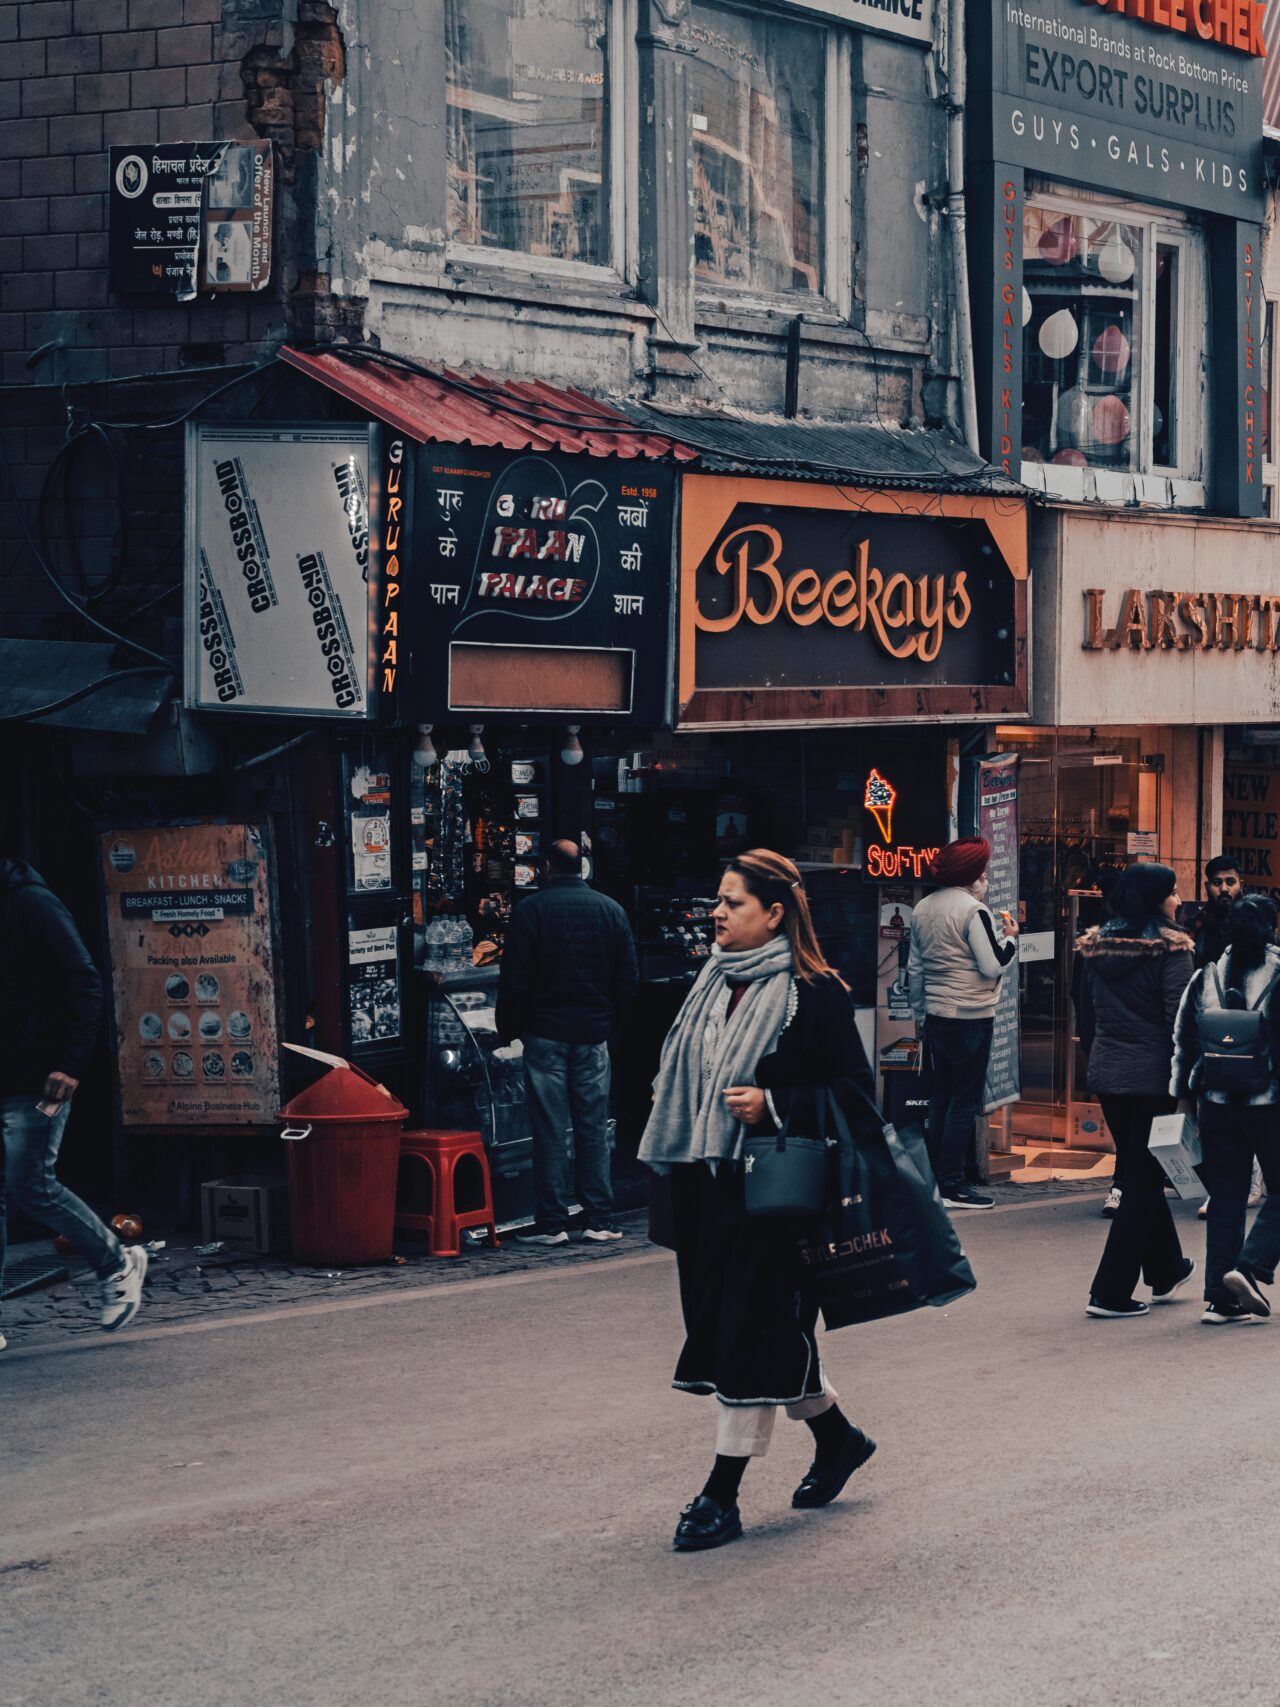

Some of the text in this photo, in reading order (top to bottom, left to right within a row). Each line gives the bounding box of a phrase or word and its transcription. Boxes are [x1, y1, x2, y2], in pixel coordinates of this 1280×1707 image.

[1192, 0, 1267, 57] CHEK
[1007, 3, 1087, 45] International
[1090, 28, 1131, 59] Brands
[1134, 47, 1146, 64] at
[1149, 47, 1176, 73] Rock
[1178, 56, 1218, 84] Bottom
[1221, 68, 1249, 94] Price
[1025, 43, 1236, 138] EXPORT SURPLUS
[152, 155, 210, 174] हिमाचल प्रदेश
[1012, 110, 1247, 192] GUYS GALS KIDS
[252, 154, 263, 279] Offer of the Month
[261, 170, 271, 263] New Launch and
[1003, 181, 1016, 270] GUYS
[1244, 243, 1254, 369] STYLE
[1001, 284, 1015, 373] GALS
[1001, 388, 1012, 476] KIDS
[1245, 385, 1255, 484] CHEK
[386, 441, 403, 550] GURU
[436, 489, 464, 522] गुरु
[621, 486, 657, 498] Estd. 1958
[617, 499, 648, 528] लबों
[438, 527, 458, 558] के
[492, 526, 586, 563] PAAN
[620, 543, 643, 571] की
[430, 584, 460, 605] पान
[478, 572, 588, 601] PALACE
[694, 523, 972, 662] Beekays
[613, 594, 644, 615] शान
[382, 583, 399, 692] PAAN
[147, 873, 224, 889] KITCHEN
[126, 897, 173, 908] BREAKFAST
[179, 895, 208, 906] LUNCH
[160, 909, 216, 919] Fresh Homely Food
[147, 954, 236, 967] Packing also Available
[204, 1102, 242, 1112] Business
[243, 1101, 260, 1111] Hub
[852, 1228, 893, 1253] CHEK
